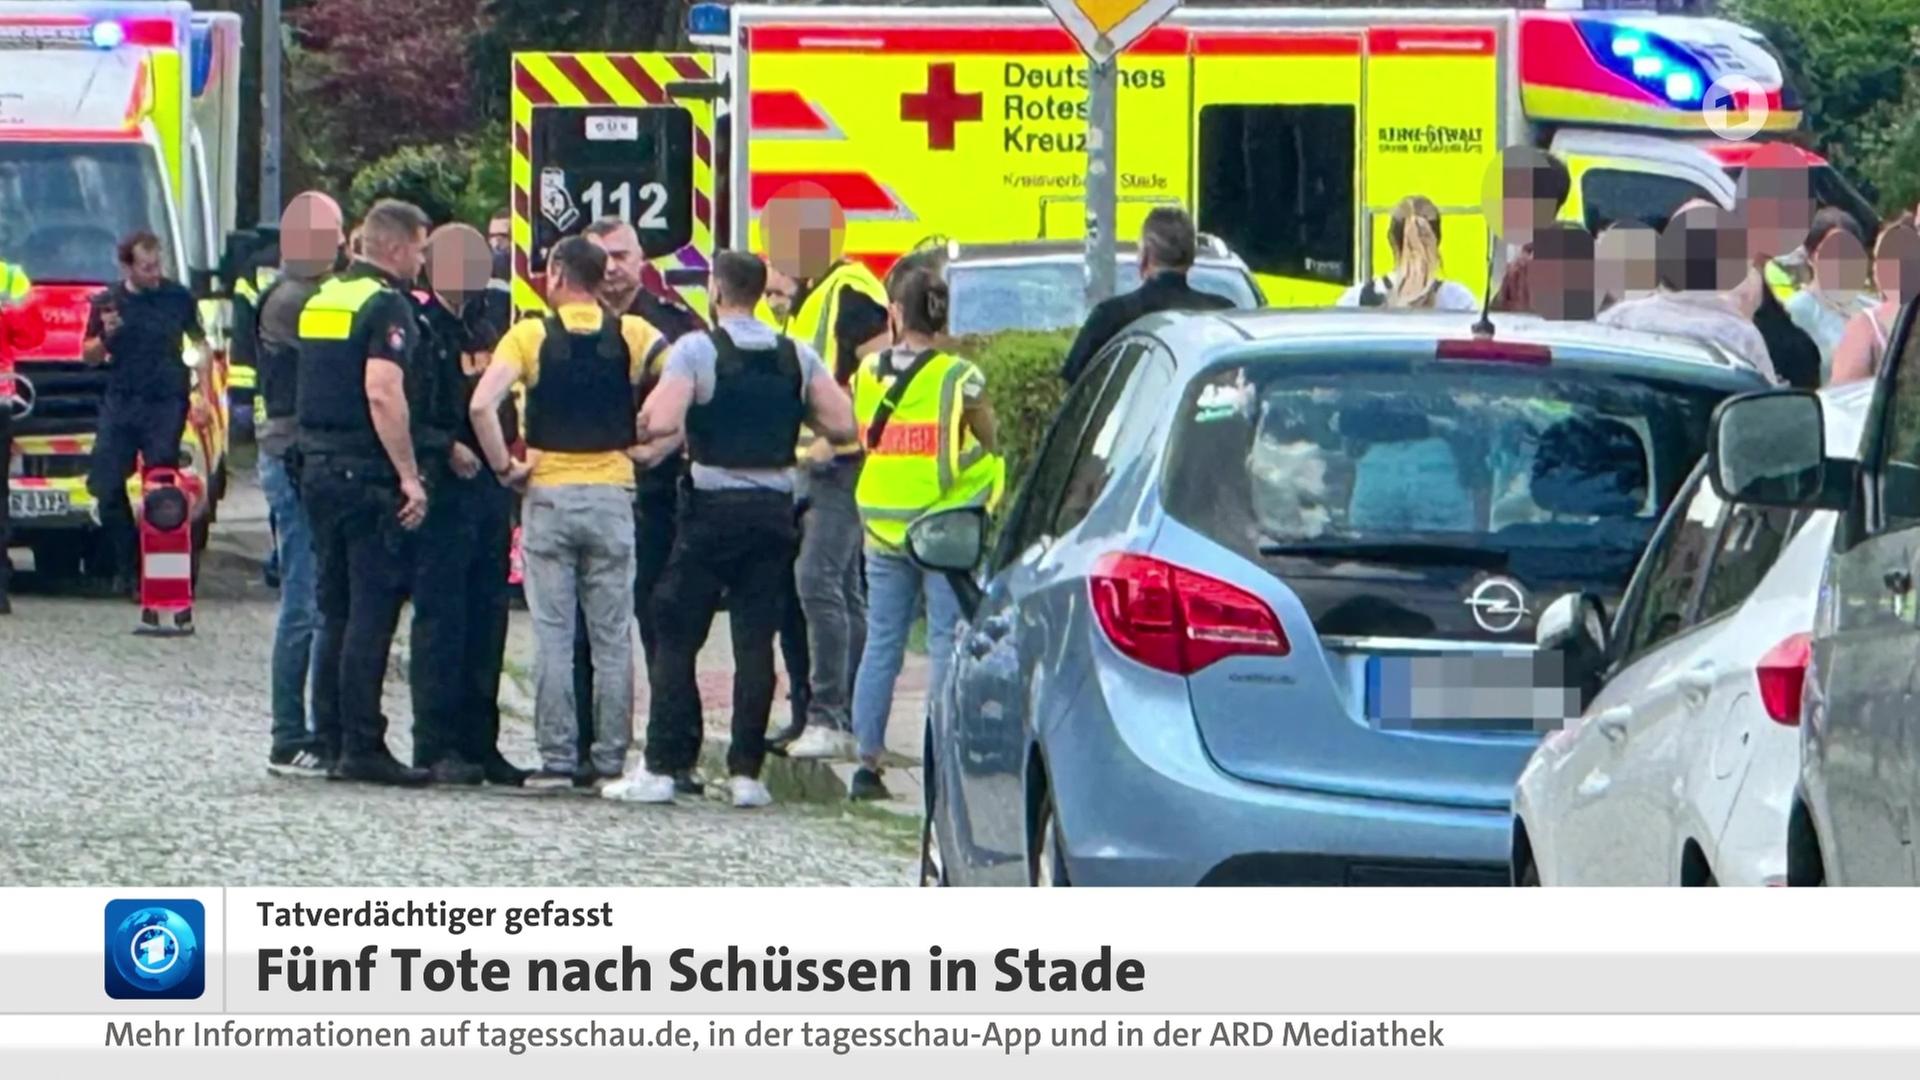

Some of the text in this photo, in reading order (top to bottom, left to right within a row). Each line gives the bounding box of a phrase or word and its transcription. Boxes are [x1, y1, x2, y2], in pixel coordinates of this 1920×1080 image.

[1004, 62, 1166, 89] Deutshes
[1004, 94, 1090, 121] Rotes
[1004, 125, 1088, 153] Kreuz
[581, 181, 669, 229] 112
